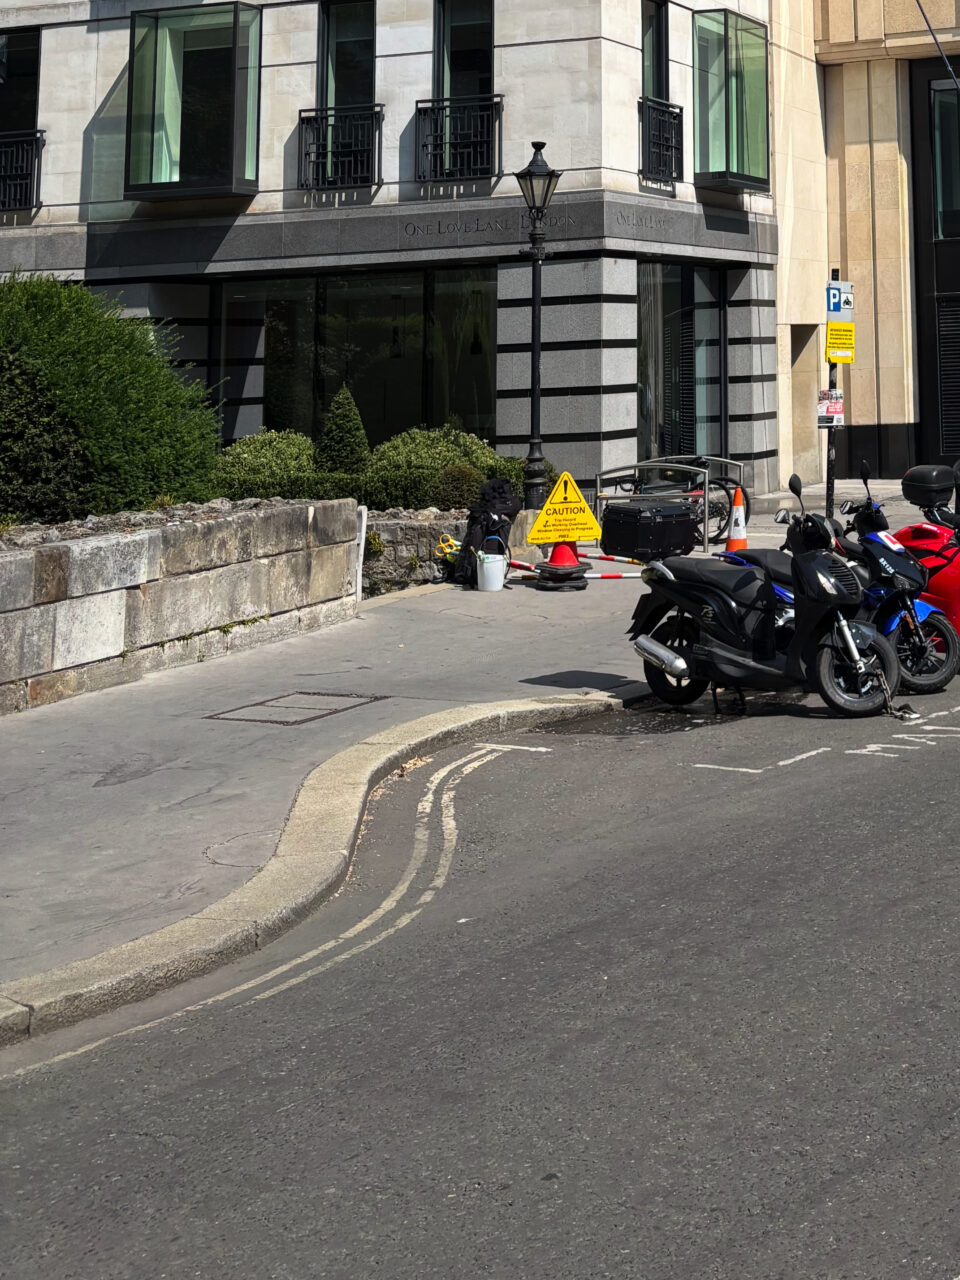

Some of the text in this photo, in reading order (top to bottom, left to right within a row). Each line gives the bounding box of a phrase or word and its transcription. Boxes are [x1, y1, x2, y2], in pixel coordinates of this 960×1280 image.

[520, 214, 576, 229] LNDON
[830, 289, 840, 310] P
[545, 507, 585, 516] CAUTION
